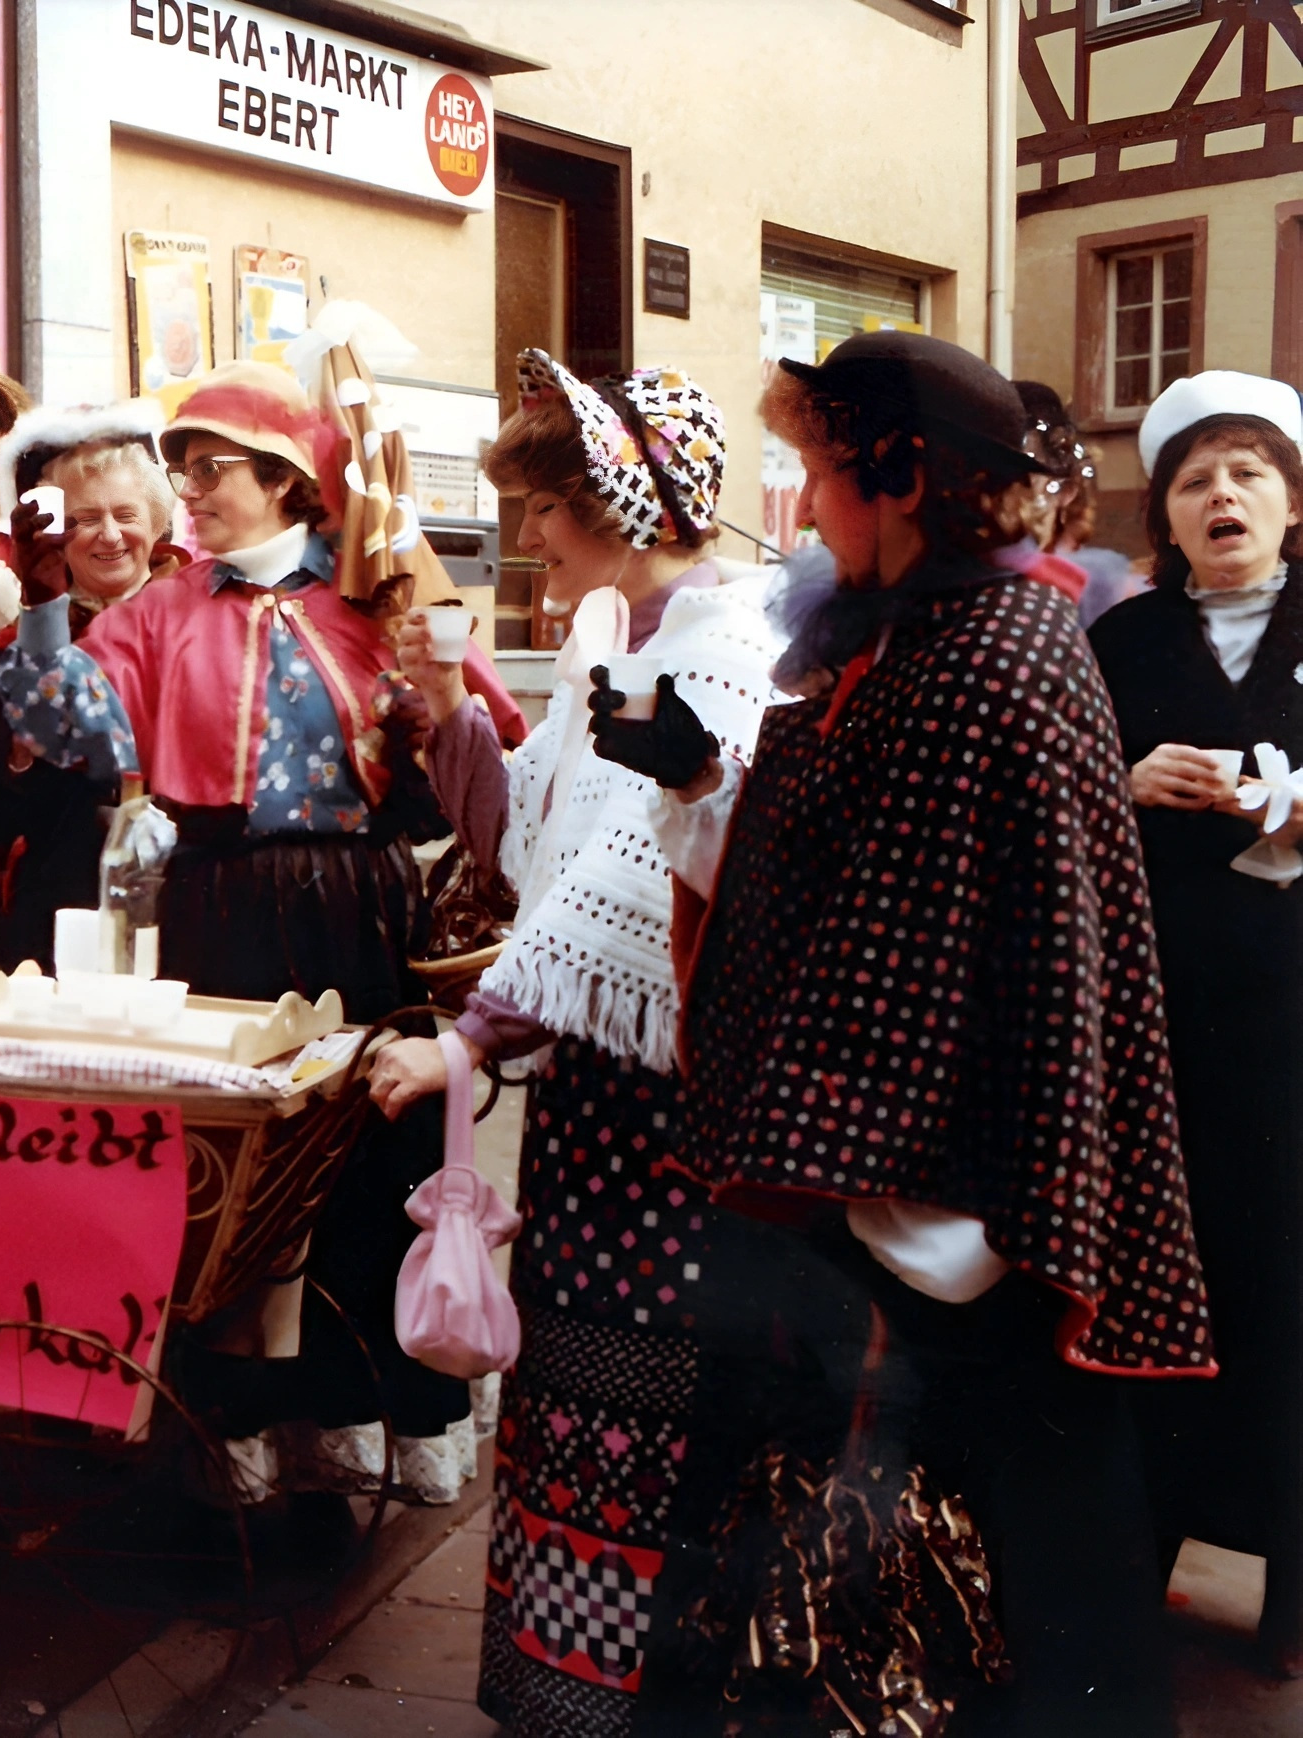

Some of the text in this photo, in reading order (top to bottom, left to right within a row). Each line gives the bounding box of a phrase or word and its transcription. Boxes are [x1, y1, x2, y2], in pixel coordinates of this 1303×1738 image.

[130, 0, 408, 111] EDEKA-MARKT
[218, 78, 340, 155] EBERT
[438, 90, 475, 123] HEY
